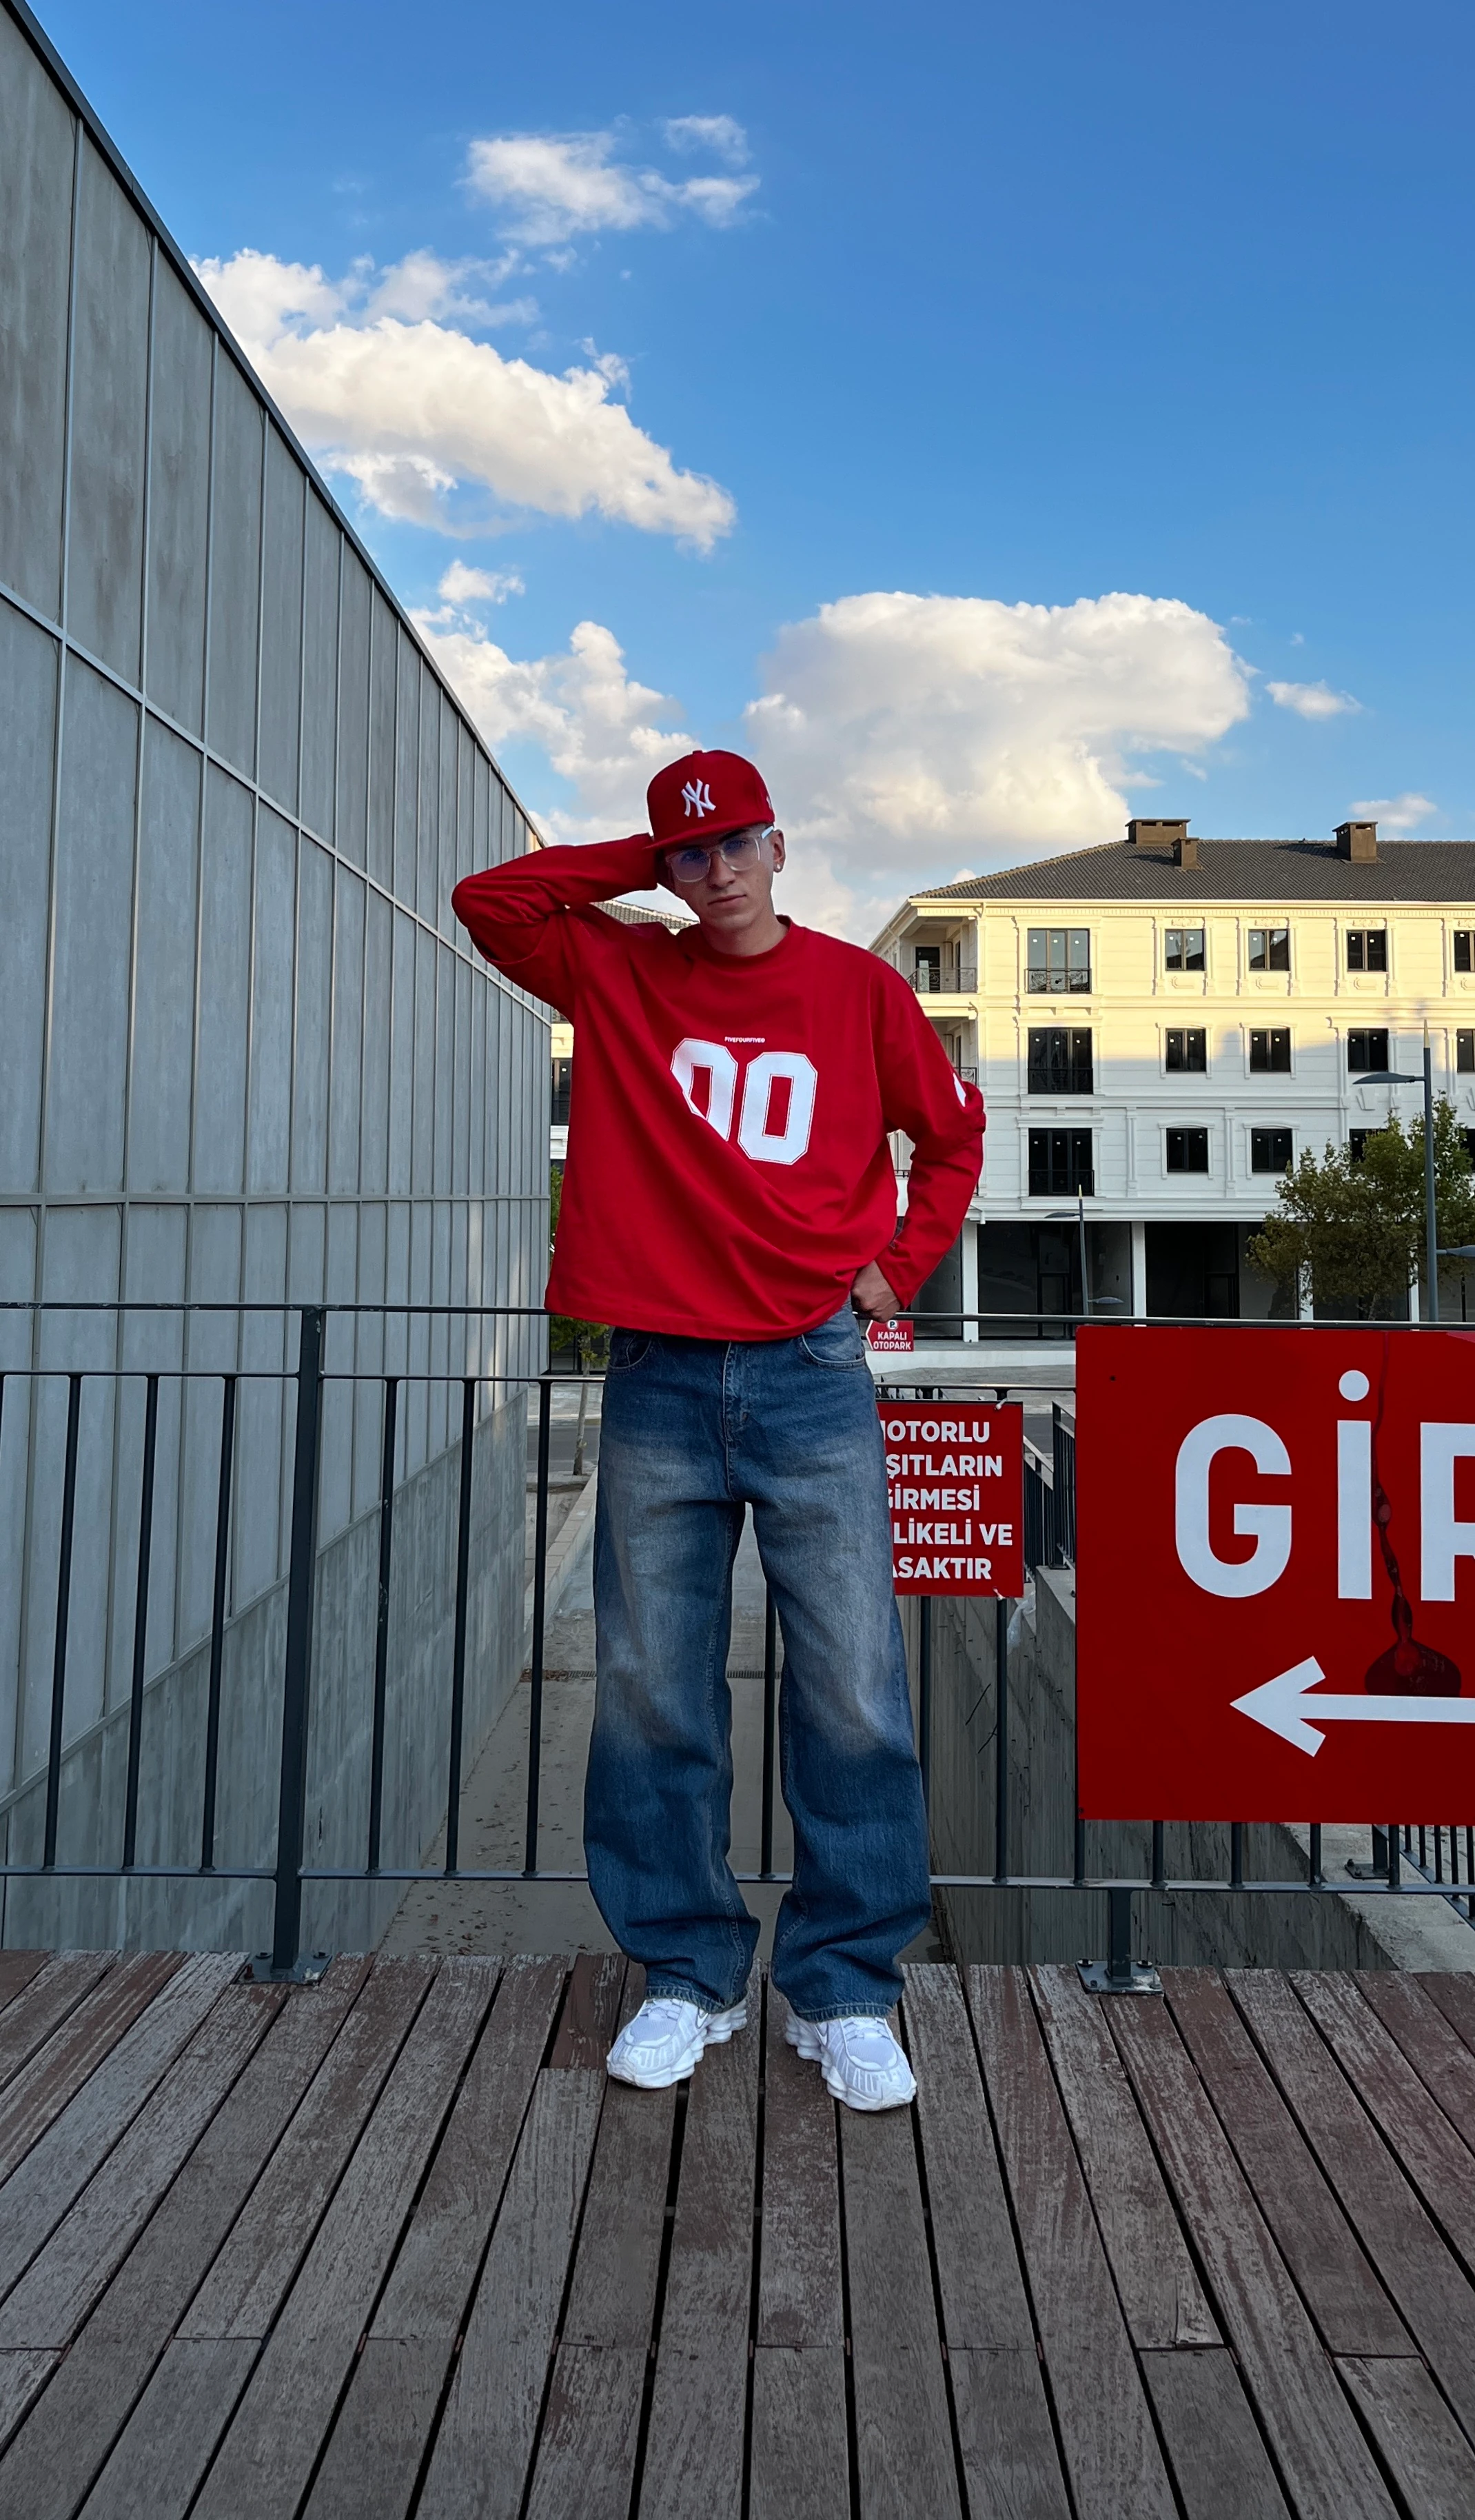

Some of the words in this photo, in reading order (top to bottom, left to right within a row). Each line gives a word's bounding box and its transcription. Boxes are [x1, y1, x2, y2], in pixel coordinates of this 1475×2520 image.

[682, 778, 716, 817] NY
[877, 1331, 907, 1340] KAPALI
[873, 1341, 911, 1350] OTOPARK
[979, 1524, 1013, 1546] VE
